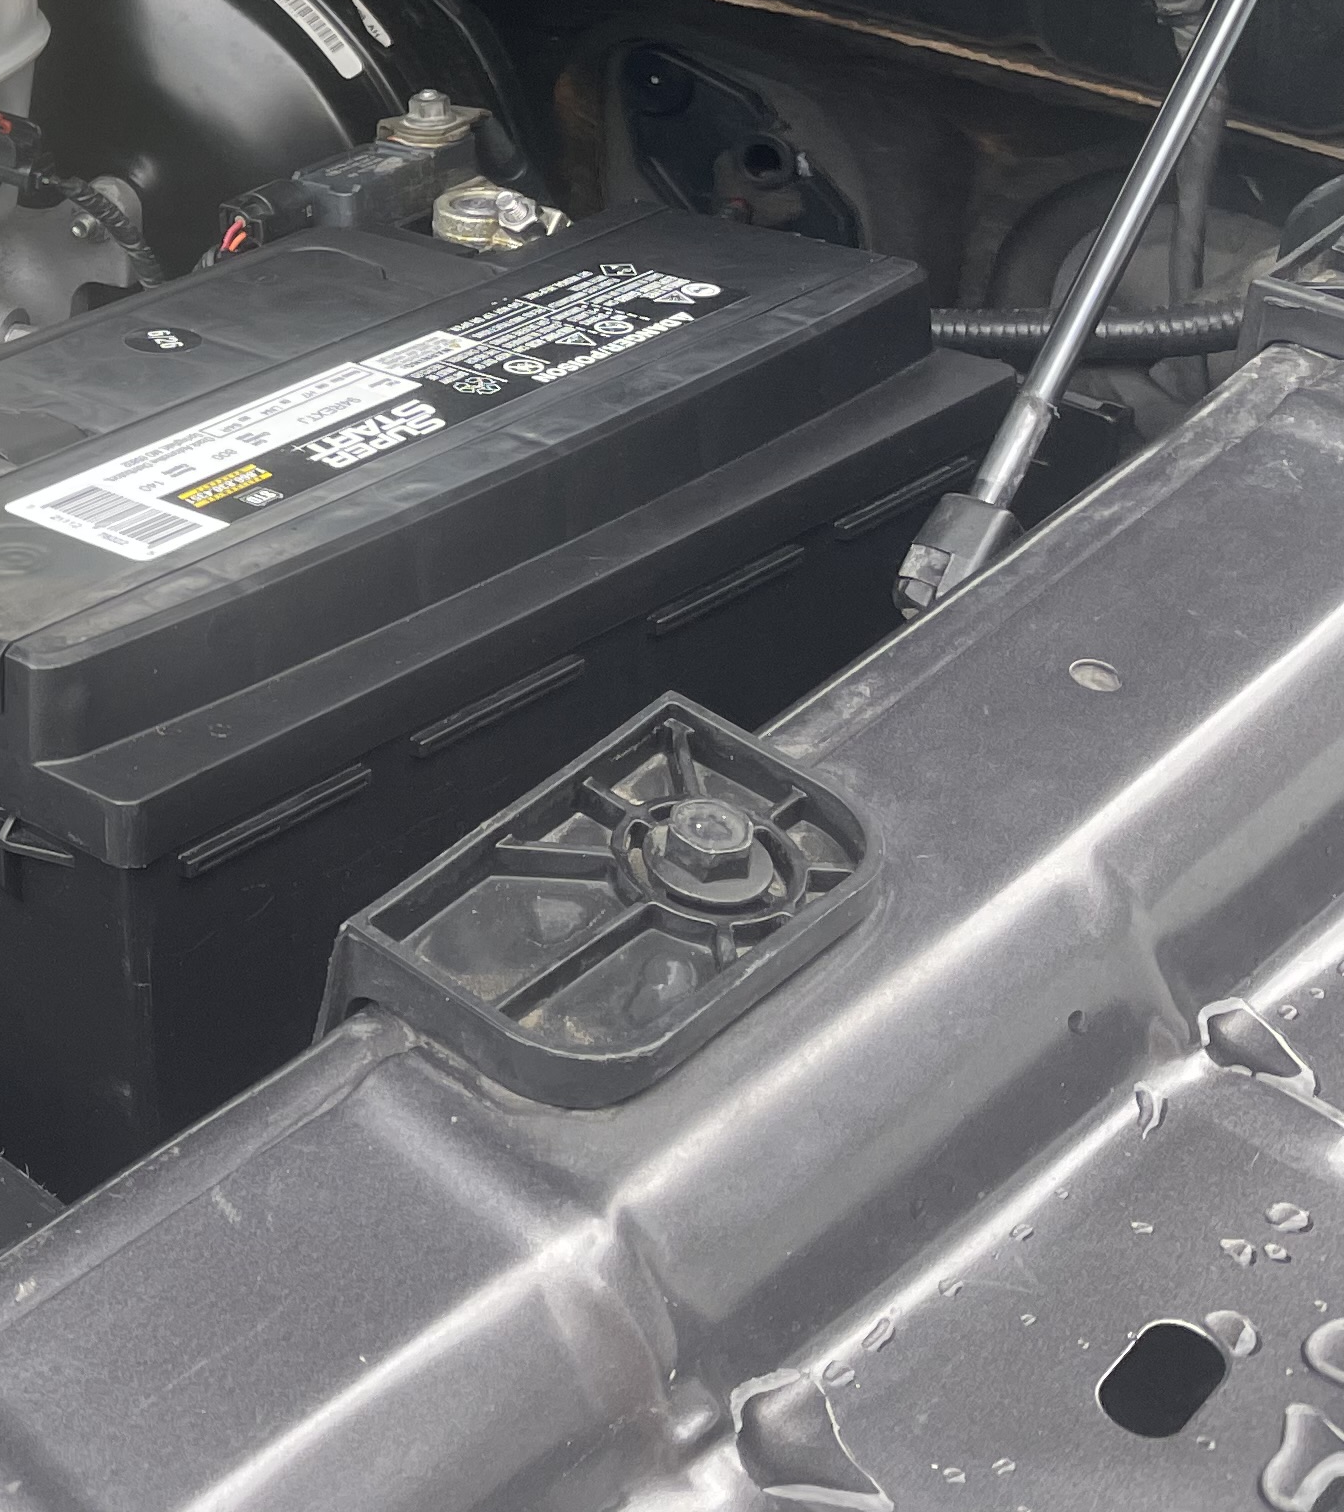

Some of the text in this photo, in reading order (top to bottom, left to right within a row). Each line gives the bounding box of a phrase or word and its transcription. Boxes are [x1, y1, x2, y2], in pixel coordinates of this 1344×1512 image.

[146, 329, 185, 349] 6/26
[531, 319, 683, 383] DANGER/POISON
[306, 399, 436, 461] START
[322, 414, 446, 468] SUPER
